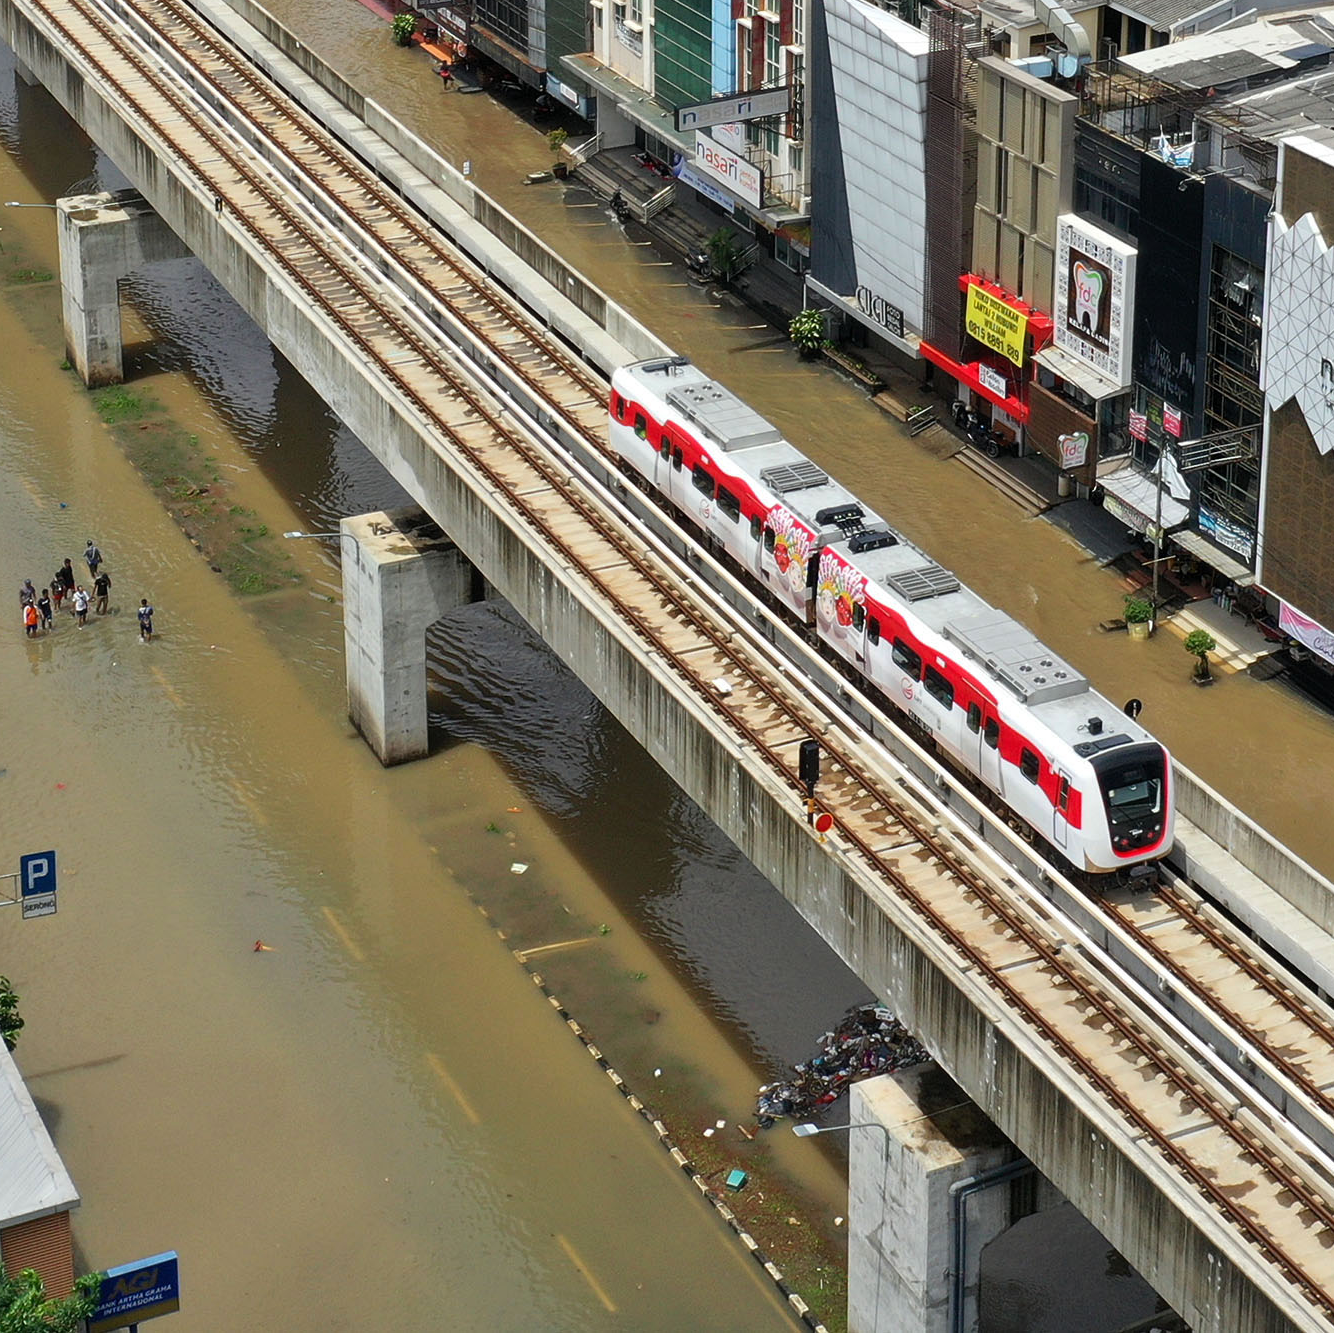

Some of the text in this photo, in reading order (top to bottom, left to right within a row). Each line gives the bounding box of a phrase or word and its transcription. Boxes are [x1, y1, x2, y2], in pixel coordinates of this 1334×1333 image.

[682, 97, 752, 125] nasari
[696, 140, 738, 181] nasari
[855, 285, 886, 326] CUCU
[1078, 282, 1098, 307] fdc
[1064, 441, 1084, 456] fdc
[27, 858, 49, 889] P
[103, 1293, 164, 1316] INTERNASIONAL
[117, 1292, 144, 1305] ARTHA
[145, 1283, 172, 1297] GRAHA
